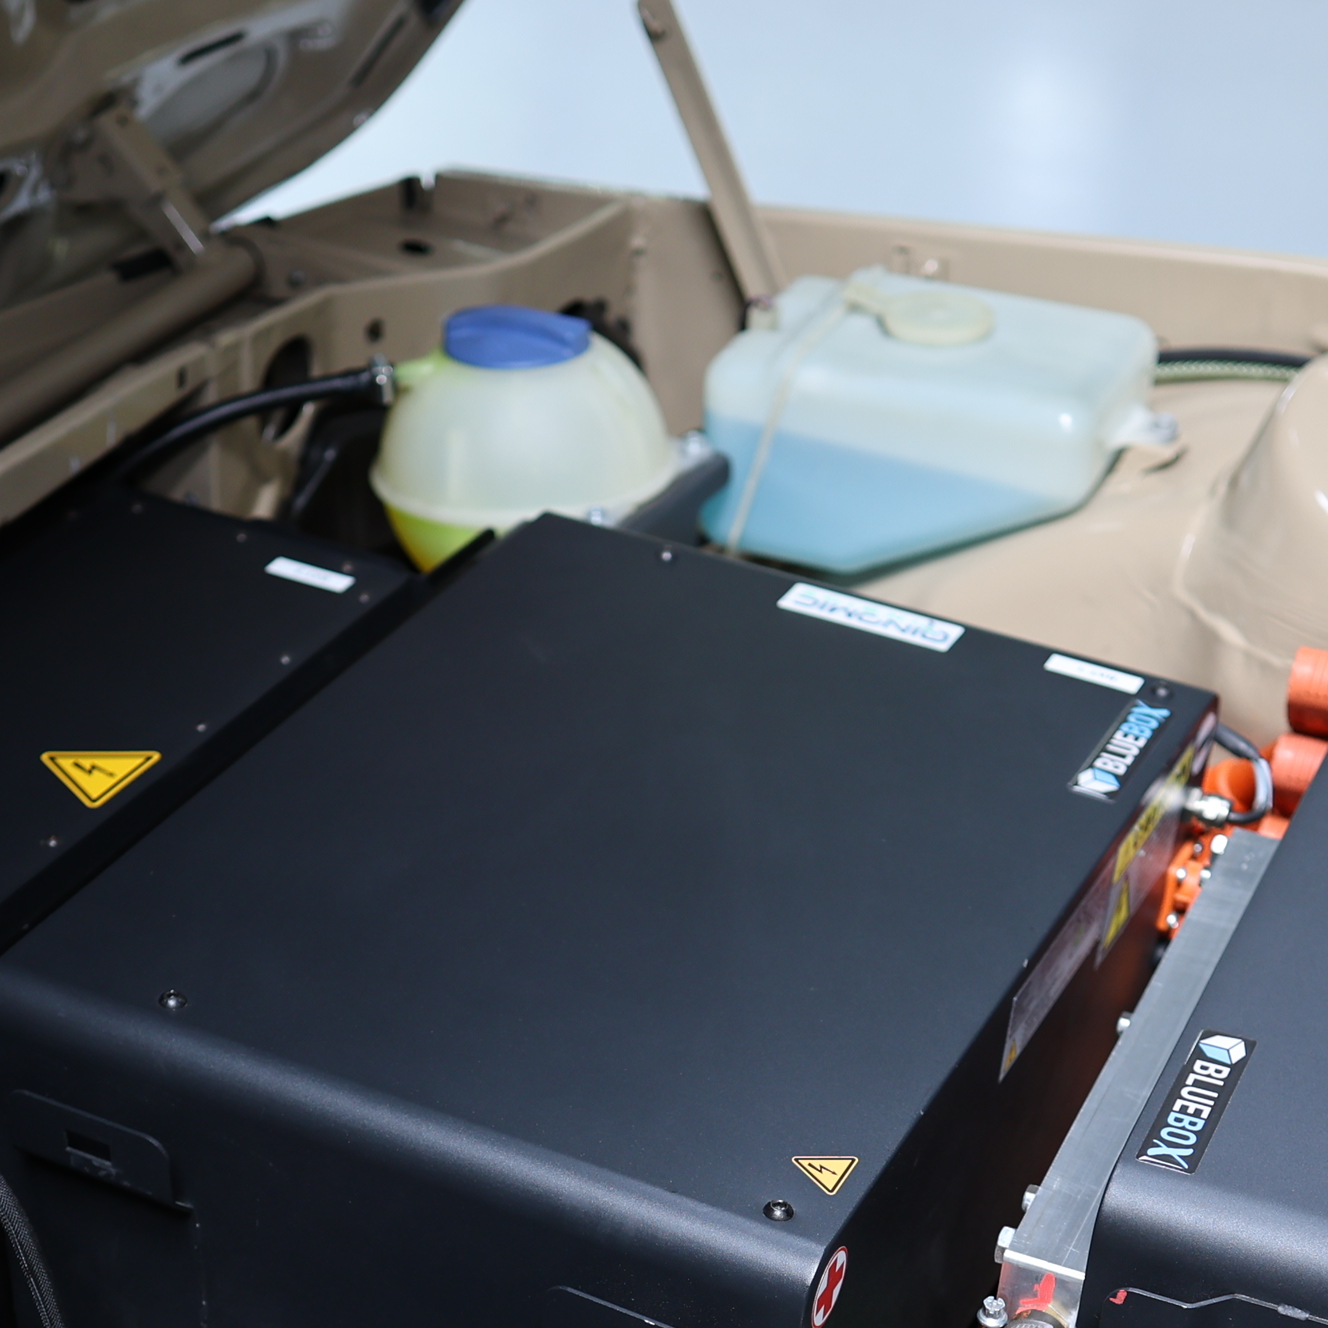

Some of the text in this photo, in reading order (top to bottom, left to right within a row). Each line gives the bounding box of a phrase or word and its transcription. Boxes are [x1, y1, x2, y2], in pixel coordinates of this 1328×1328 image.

[793, 593, 950, 643] QINOMIC
[1092, 699, 1172, 776] BLUEBOX
[1146, 1059, 1232, 1170] BLUEBOX
